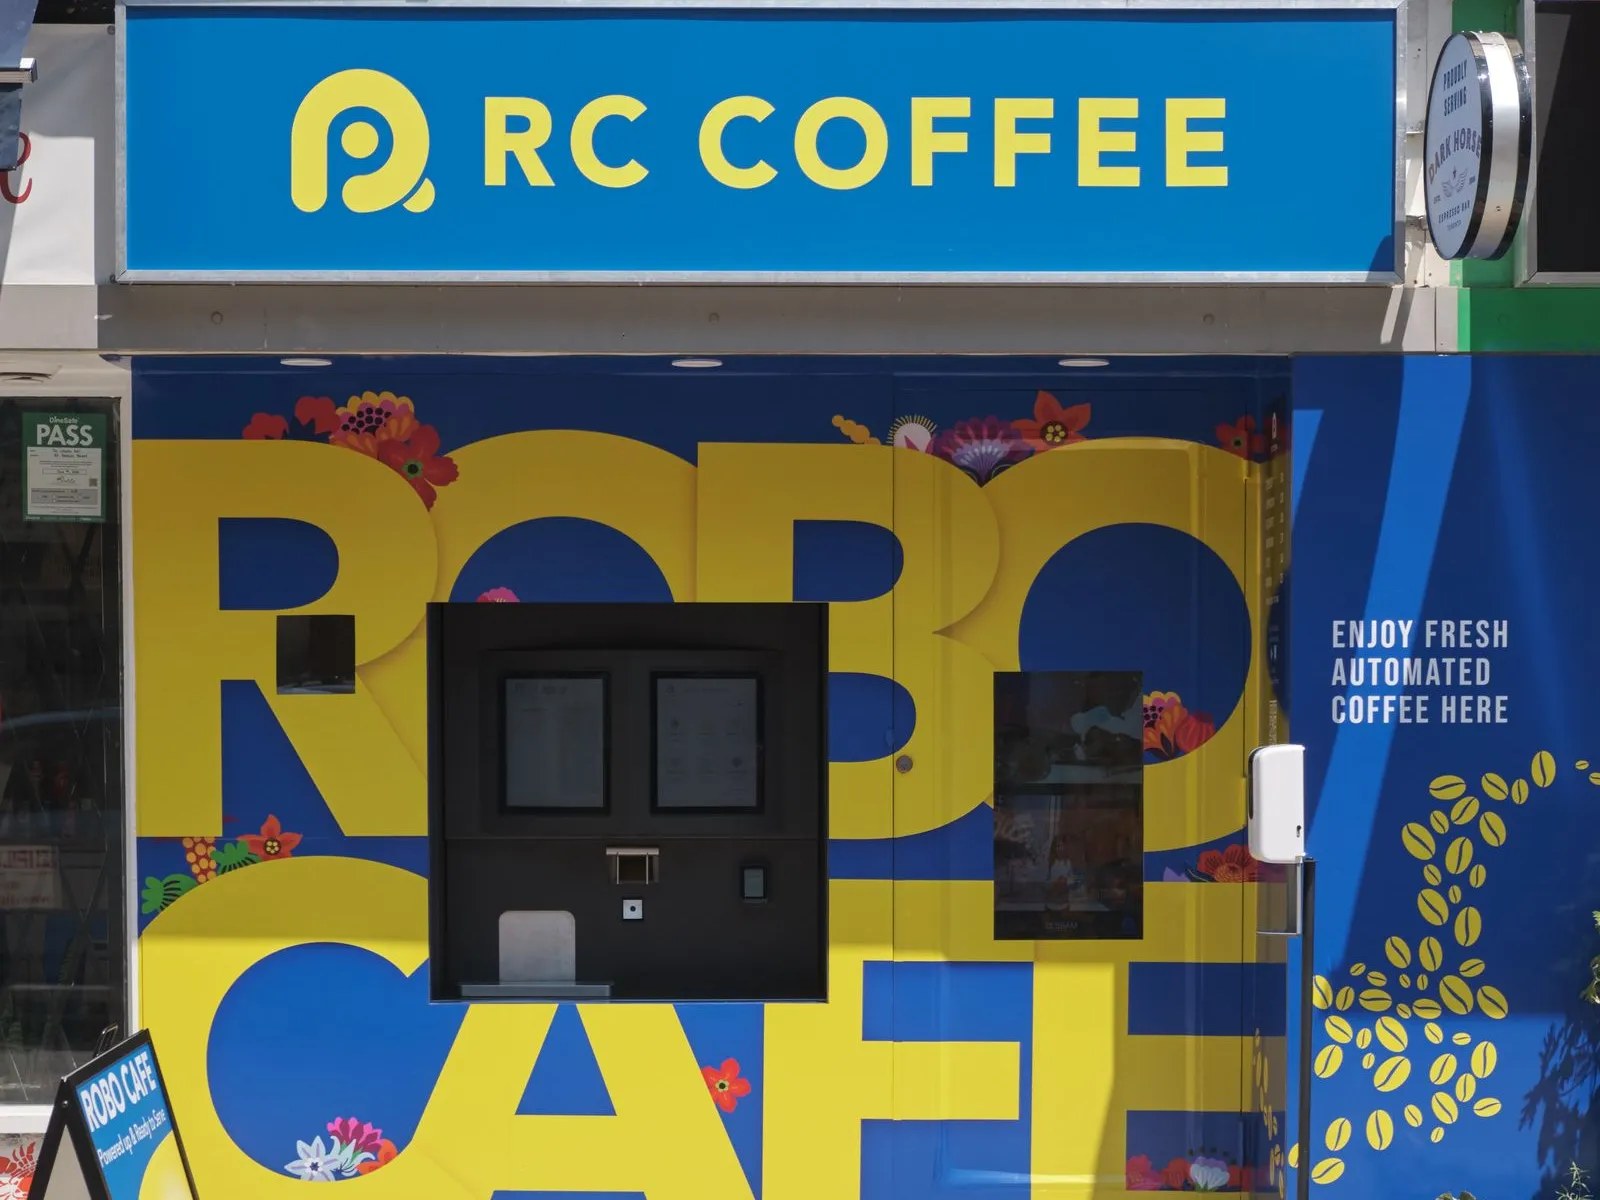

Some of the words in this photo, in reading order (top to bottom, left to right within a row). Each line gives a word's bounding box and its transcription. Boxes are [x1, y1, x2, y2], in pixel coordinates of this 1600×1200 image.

[1443, 60, 1468, 91] PROUDLY
[1443, 86, 1467, 117] SERVING
[485, 95, 647, 188] RC
[699, 96, 1228, 190] COFFEE
[1428, 135, 1451, 184] DARK
[1453, 127, 1481, 158] HORSE
[37, 424, 94, 447] PASS
[1332, 619, 1413, 649] ENJOY
[1425, 619, 1509, 649] FRESH
[1331, 657, 1491, 687] AUTOMATED
[1331, 695, 1429, 724] COFFEE
[1441, 695, 1509, 724] HERE
[80, 1071, 126, 1133] ROBO
[120, 1051, 157, 1105] CAFE
[97, 1133, 125, 1168] Powered
[122, 1136, 134, 1155] up
[133, 1117, 153, 1140] Ready
[153, 1109, 166, 1128] Serve
